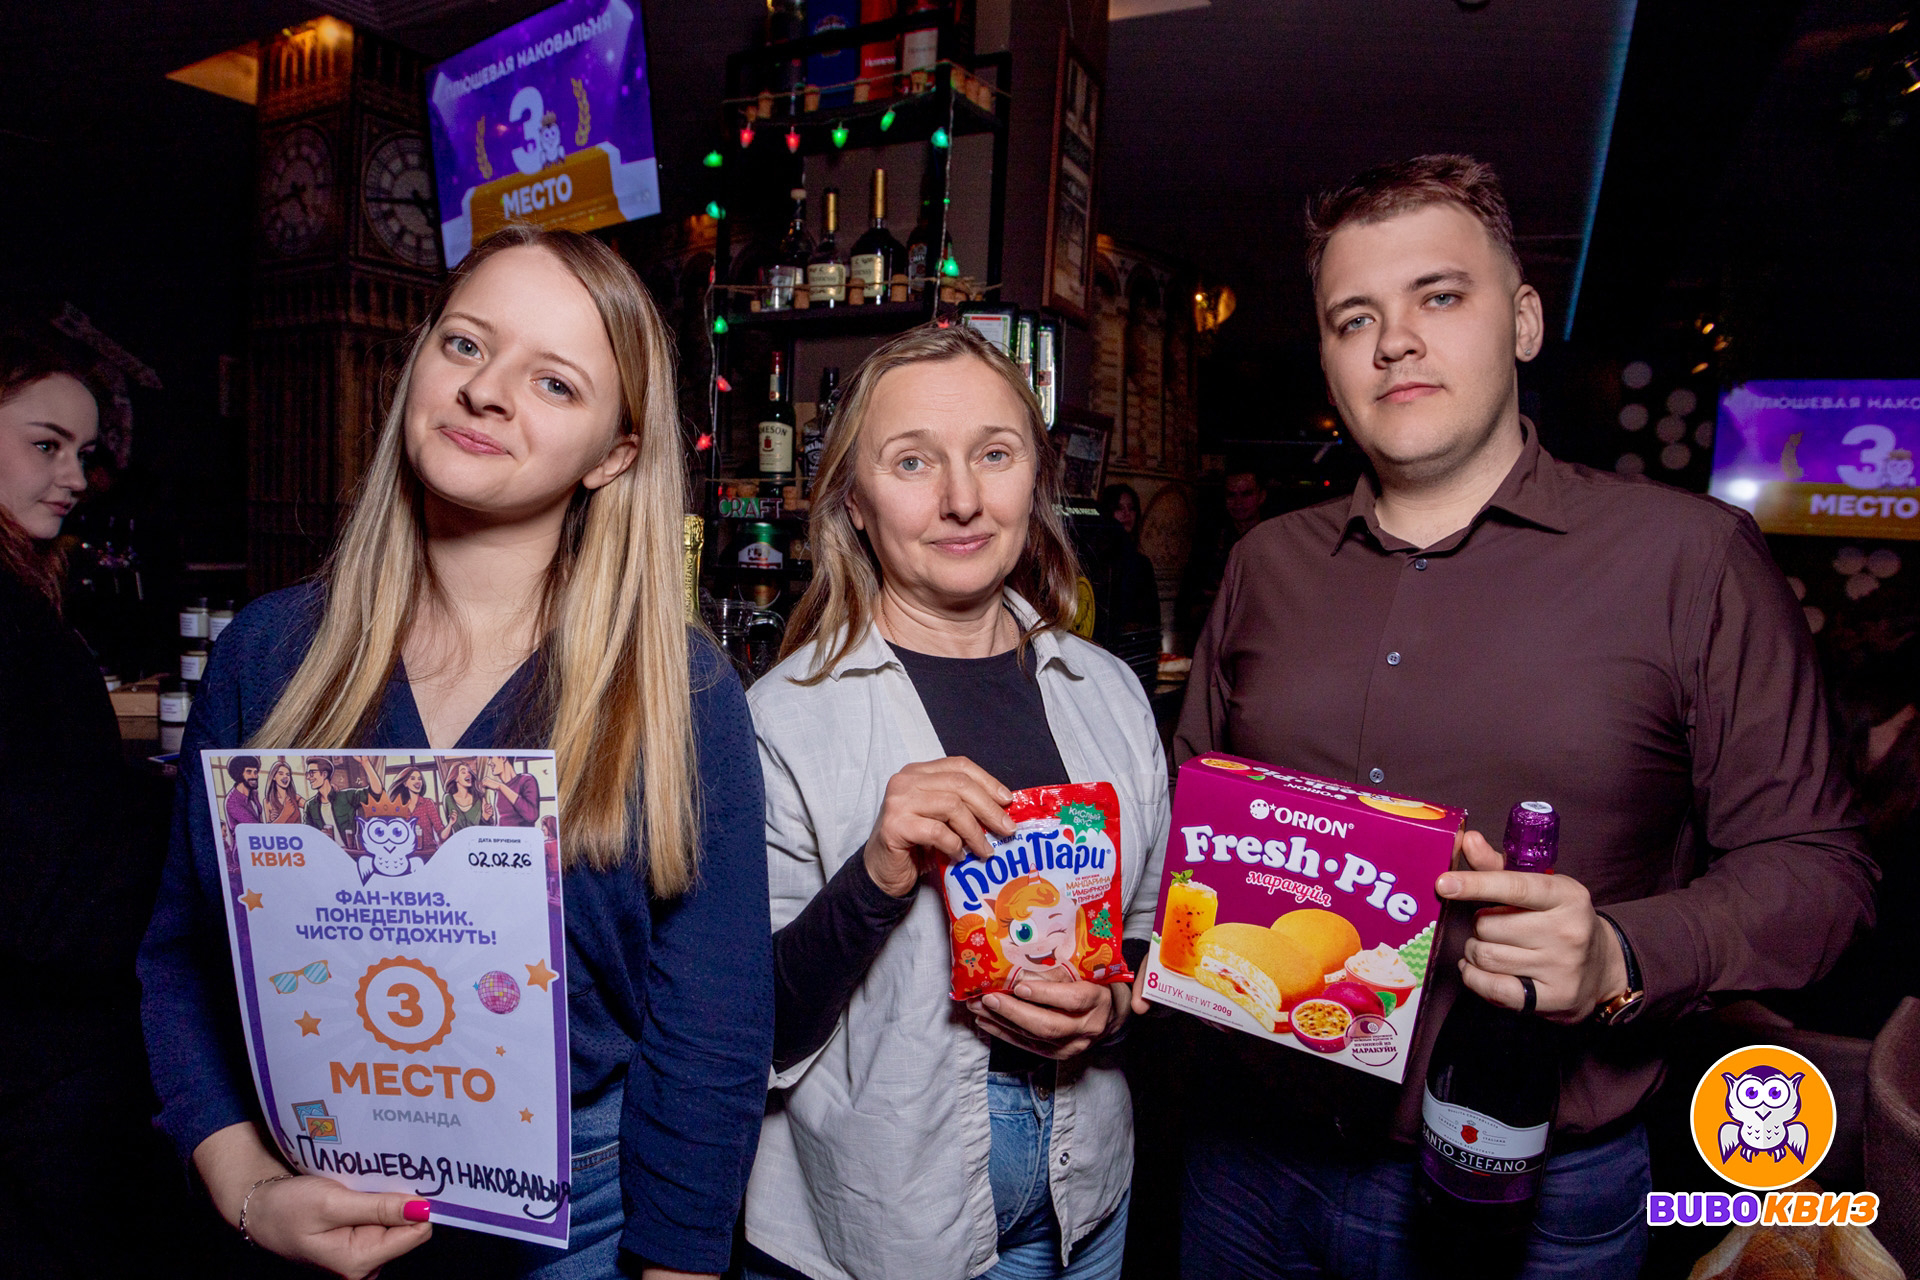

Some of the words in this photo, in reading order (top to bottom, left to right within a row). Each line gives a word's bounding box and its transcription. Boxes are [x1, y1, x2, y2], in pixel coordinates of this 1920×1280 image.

[517, 12, 613, 68] НАКОВАЛЬНЯ
[509, 86, 544, 175] 3
[503, 174, 573, 219] МЕСТО
[1836, 424, 1896, 490] 3
[719, 497, 783, 519] CRAFT
[1809, 494, 1919, 519] МЕСТО
[1273, 806, 1348, 839] ORION
[249, 835, 304, 851] BUBO
[251, 851, 306, 868] КВИЗ
[468, 851, 532, 868] 02.02.26
[335, 890, 451, 907] ФАН-КВИЗ.
[1246, 870, 1332, 907] маракуйя
[316, 907, 474, 926] ПОНЕДЕЛЬНИК.
[296, 925, 364, 941] ЧИСТО
[369, 927, 497, 946] ОТДОХНУТЬ!
[386, 983, 424, 1028] 3
[1185, 994, 1199, 1004] NET
[1200, 999, 1211, 1008] WT
[1213, 1003, 1232, 1016] 200g
[329, 1061, 496, 1103] МЕСТО
[372, 1108, 462, 1127] КОМАНДА
[1460, 1151, 1527, 1172] STEFANO
